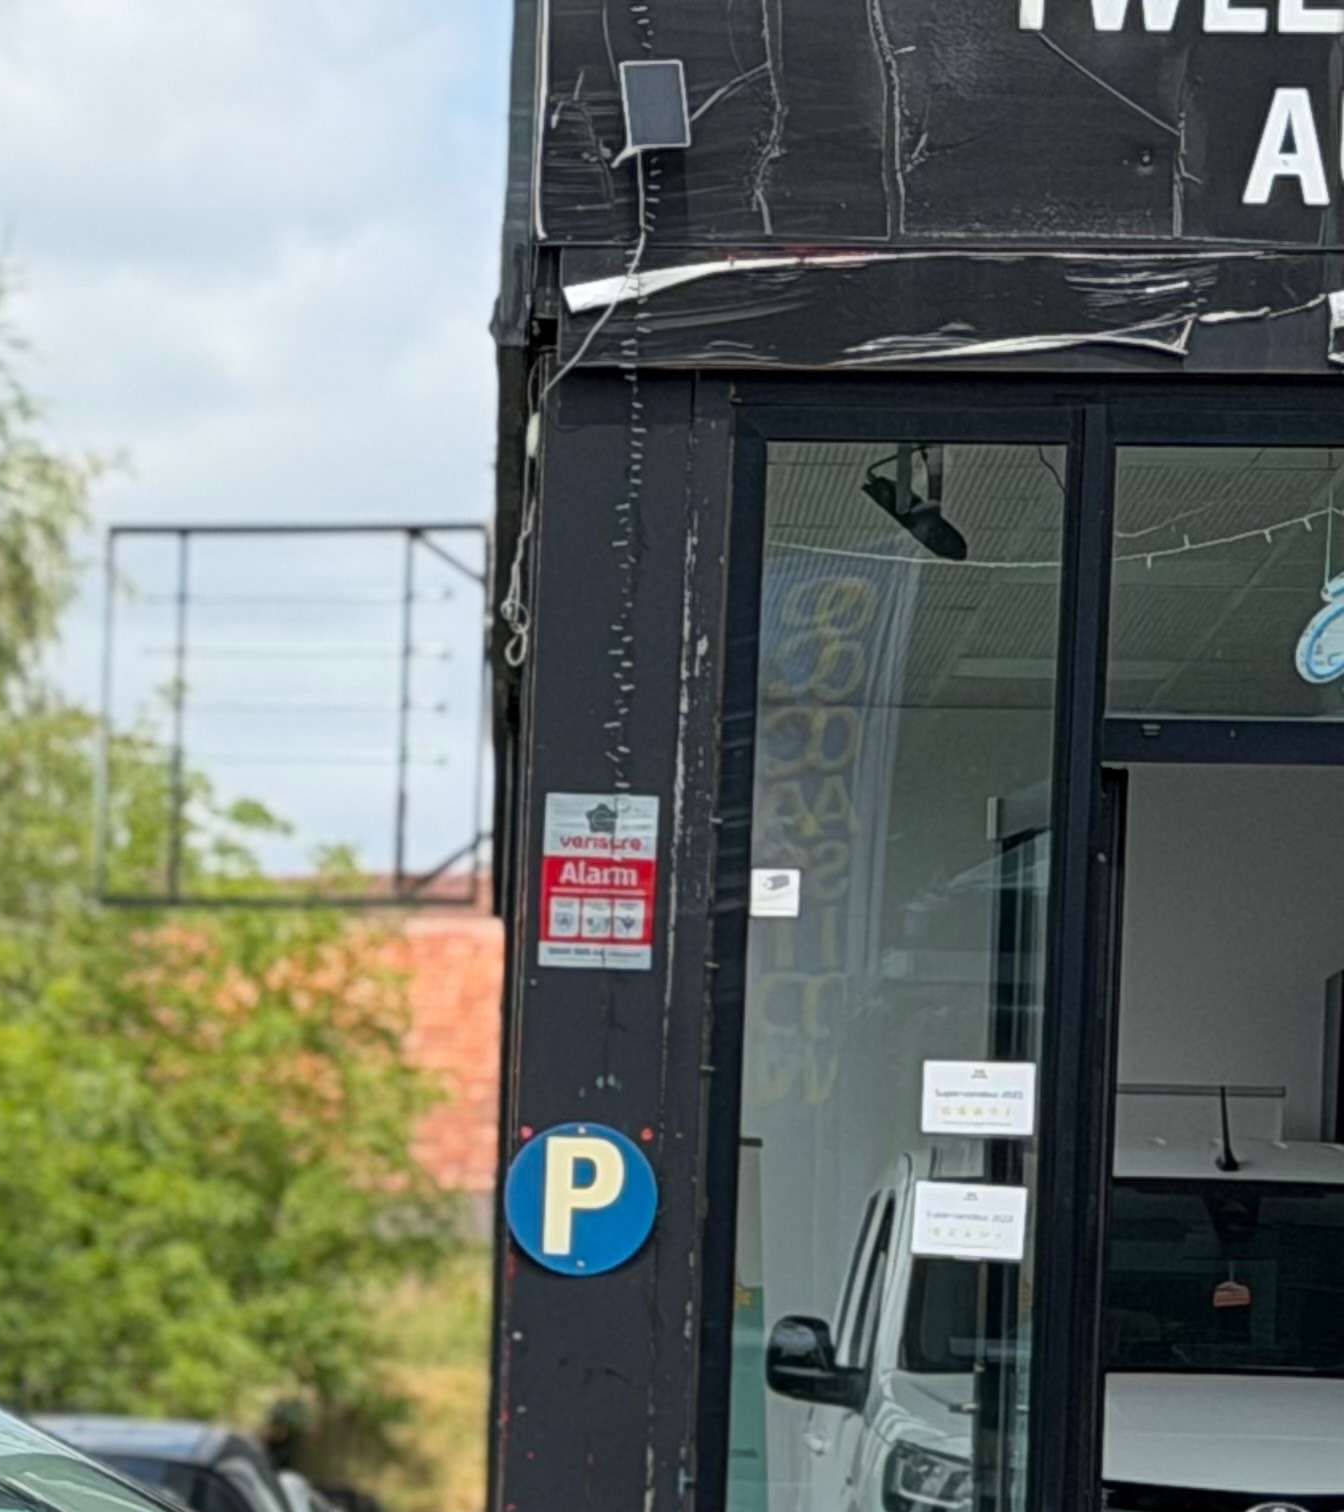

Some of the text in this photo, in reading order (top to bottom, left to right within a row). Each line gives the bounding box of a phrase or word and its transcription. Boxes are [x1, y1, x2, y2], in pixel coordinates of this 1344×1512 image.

[1241, 87, 1344, 205] A
[559, 860, 639, 886] Alarm
[541, 1135, 626, 1255] P
